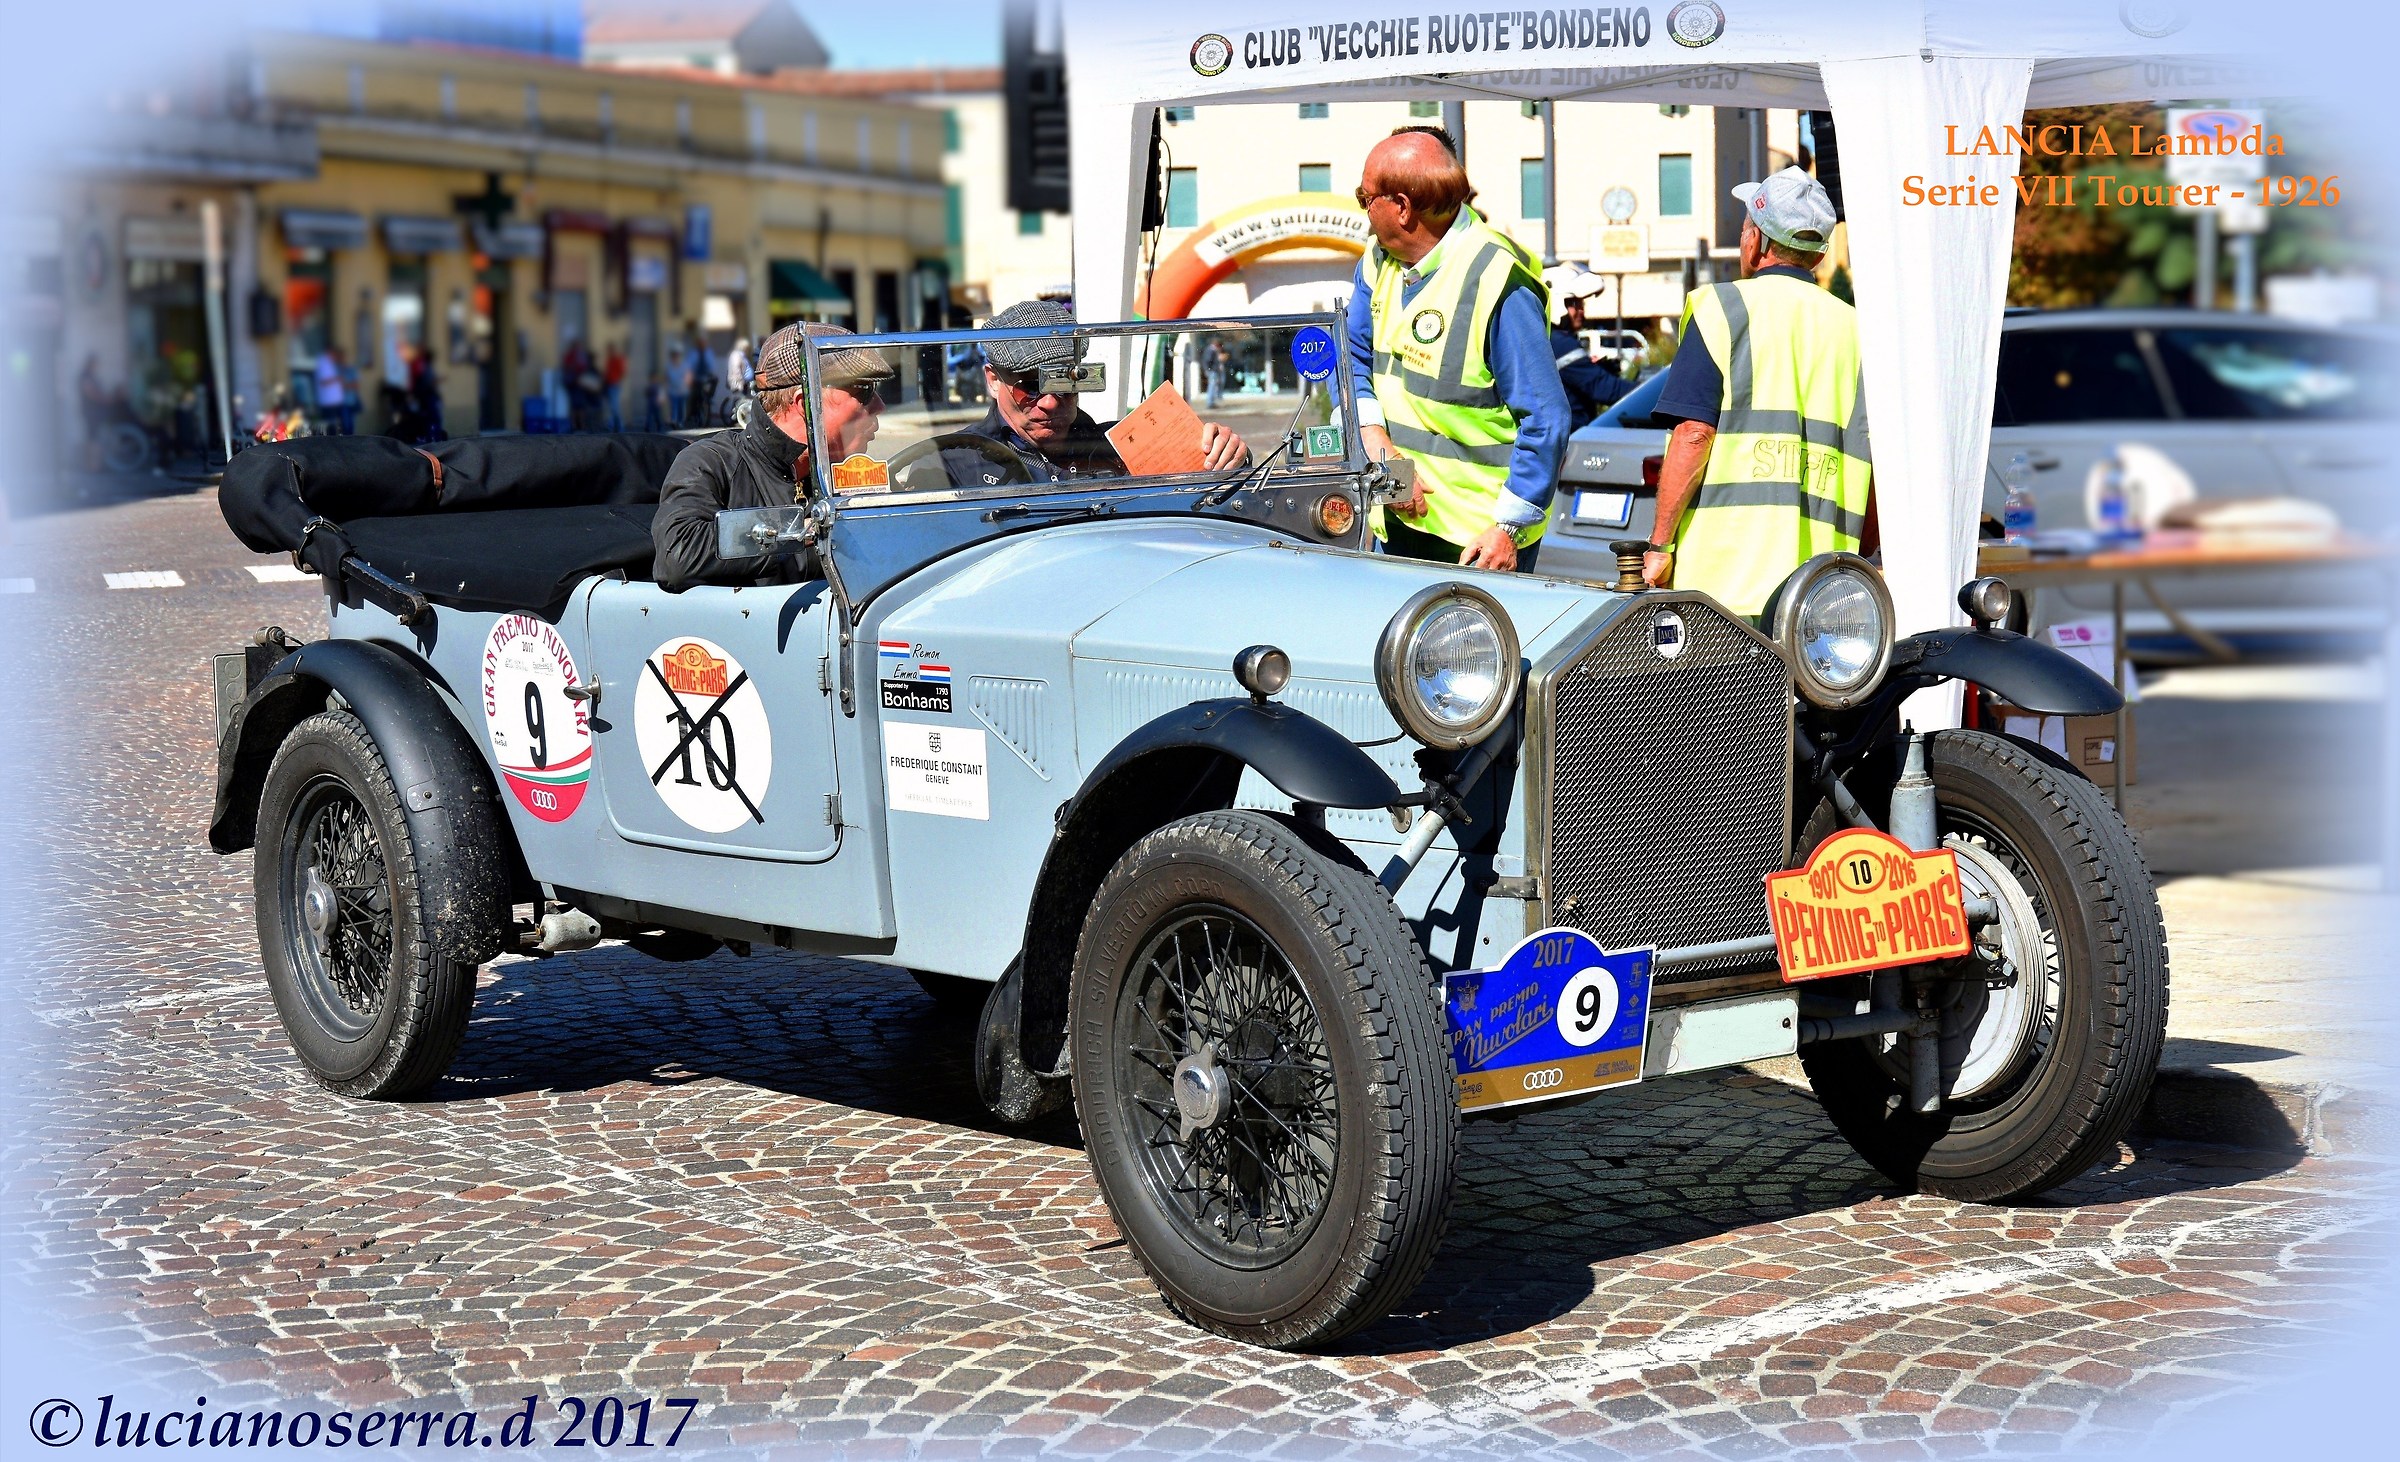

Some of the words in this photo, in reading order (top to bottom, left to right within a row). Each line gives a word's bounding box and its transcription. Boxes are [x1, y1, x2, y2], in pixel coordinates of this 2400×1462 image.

[1244, 28, 1301, 69] CLUB
[1672, 31, 1701, 47] BONDENO
[1300, 341, 1326, 354] 2017
[1303, 368, 1330, 380] PASSED
[834, 467, 862, 487] PEKING
[864, 464, 887, 485] PARIS
[912, 643, 940, 660] Remon
[484, 648, 498, 717] GRAN
[493, 615, 539, 653] PREMIO
[665, 658, 698, 691] PEKING
[700, 664, 727, 694] PARIS
[893, 664, 918, 680] Emma
[883, 682, 904, 690] Supported
[936, 687, 949, 696] 1793
[884, 691, 950, 711] Bonhams
[524, 681, 547, 771] 9
[666, 707, 737, 791] 10
[890, 756, 939, 771] FREDERIQUE
[941, 761, 983, 776] CONSTANT
[925, 774, 950, 785] GENEVE
[1809, 860, 1839, 900] 1907
[1850, 859, 1873, 886] 10
[1884, 852, 1918, 891] 2016
[1777, 896, 1879, 970] PEKING
[1872, 921, 1886, 943] TO
[1882, 873, 1964, 955] PARIS
[1532, 936, 1576, 969] 2017
[1450, 1016, 1482, 1046] RAN
[1490, 981, 1540, 1022] PREMIO
[1574, 984, 1601, 1033] 9
[1463, 995, 1555, 1067] Nuvolari
